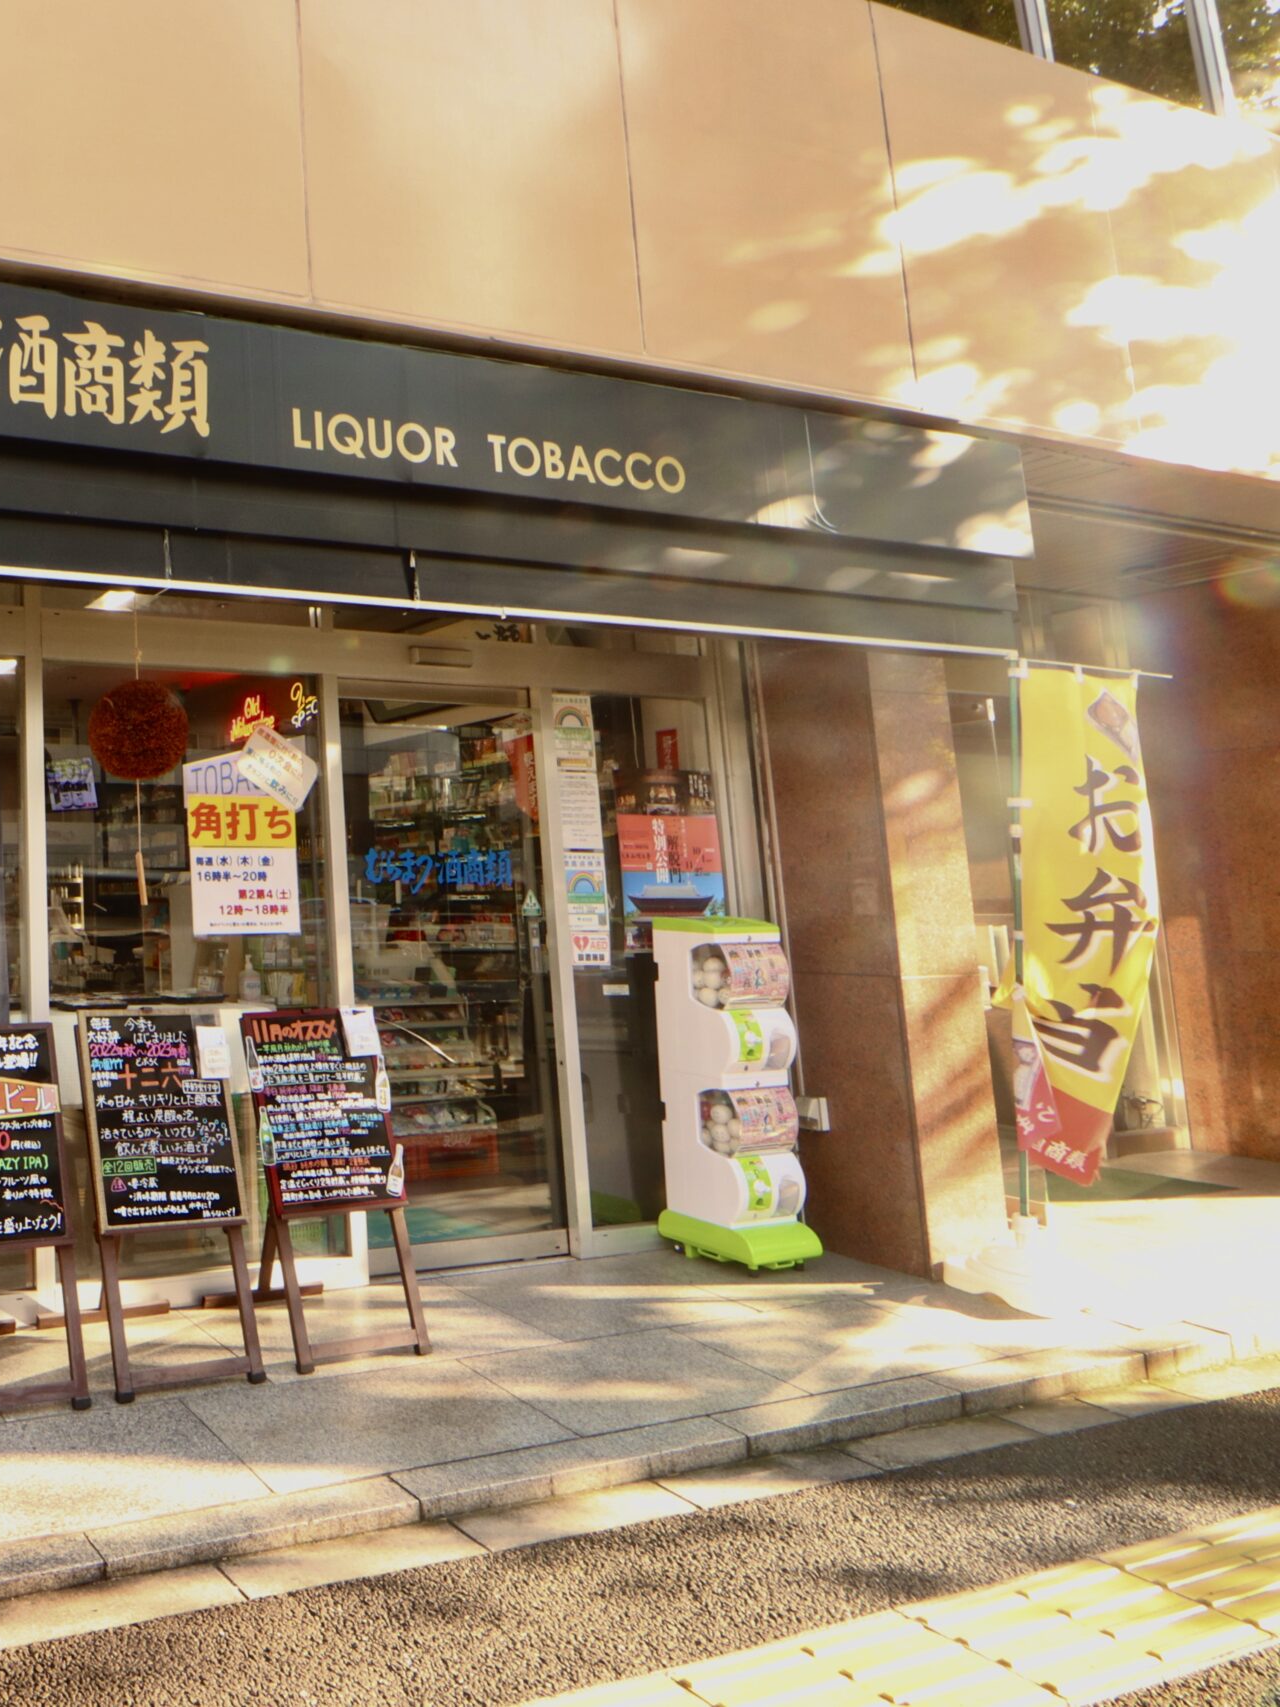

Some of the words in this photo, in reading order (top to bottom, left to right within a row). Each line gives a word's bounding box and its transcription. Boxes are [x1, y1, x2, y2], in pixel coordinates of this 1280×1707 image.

[292, 407, 459, 468] LIQUOR
[487, 432, 687, 494] TOBACCO
[191, 760, 261, 794] TOBA
[190, 802, 292, 841] 角打ち
[252, 1019, 338, 1044] 11月のオススメ
[117, 1061, 182, 1090] 十二六
